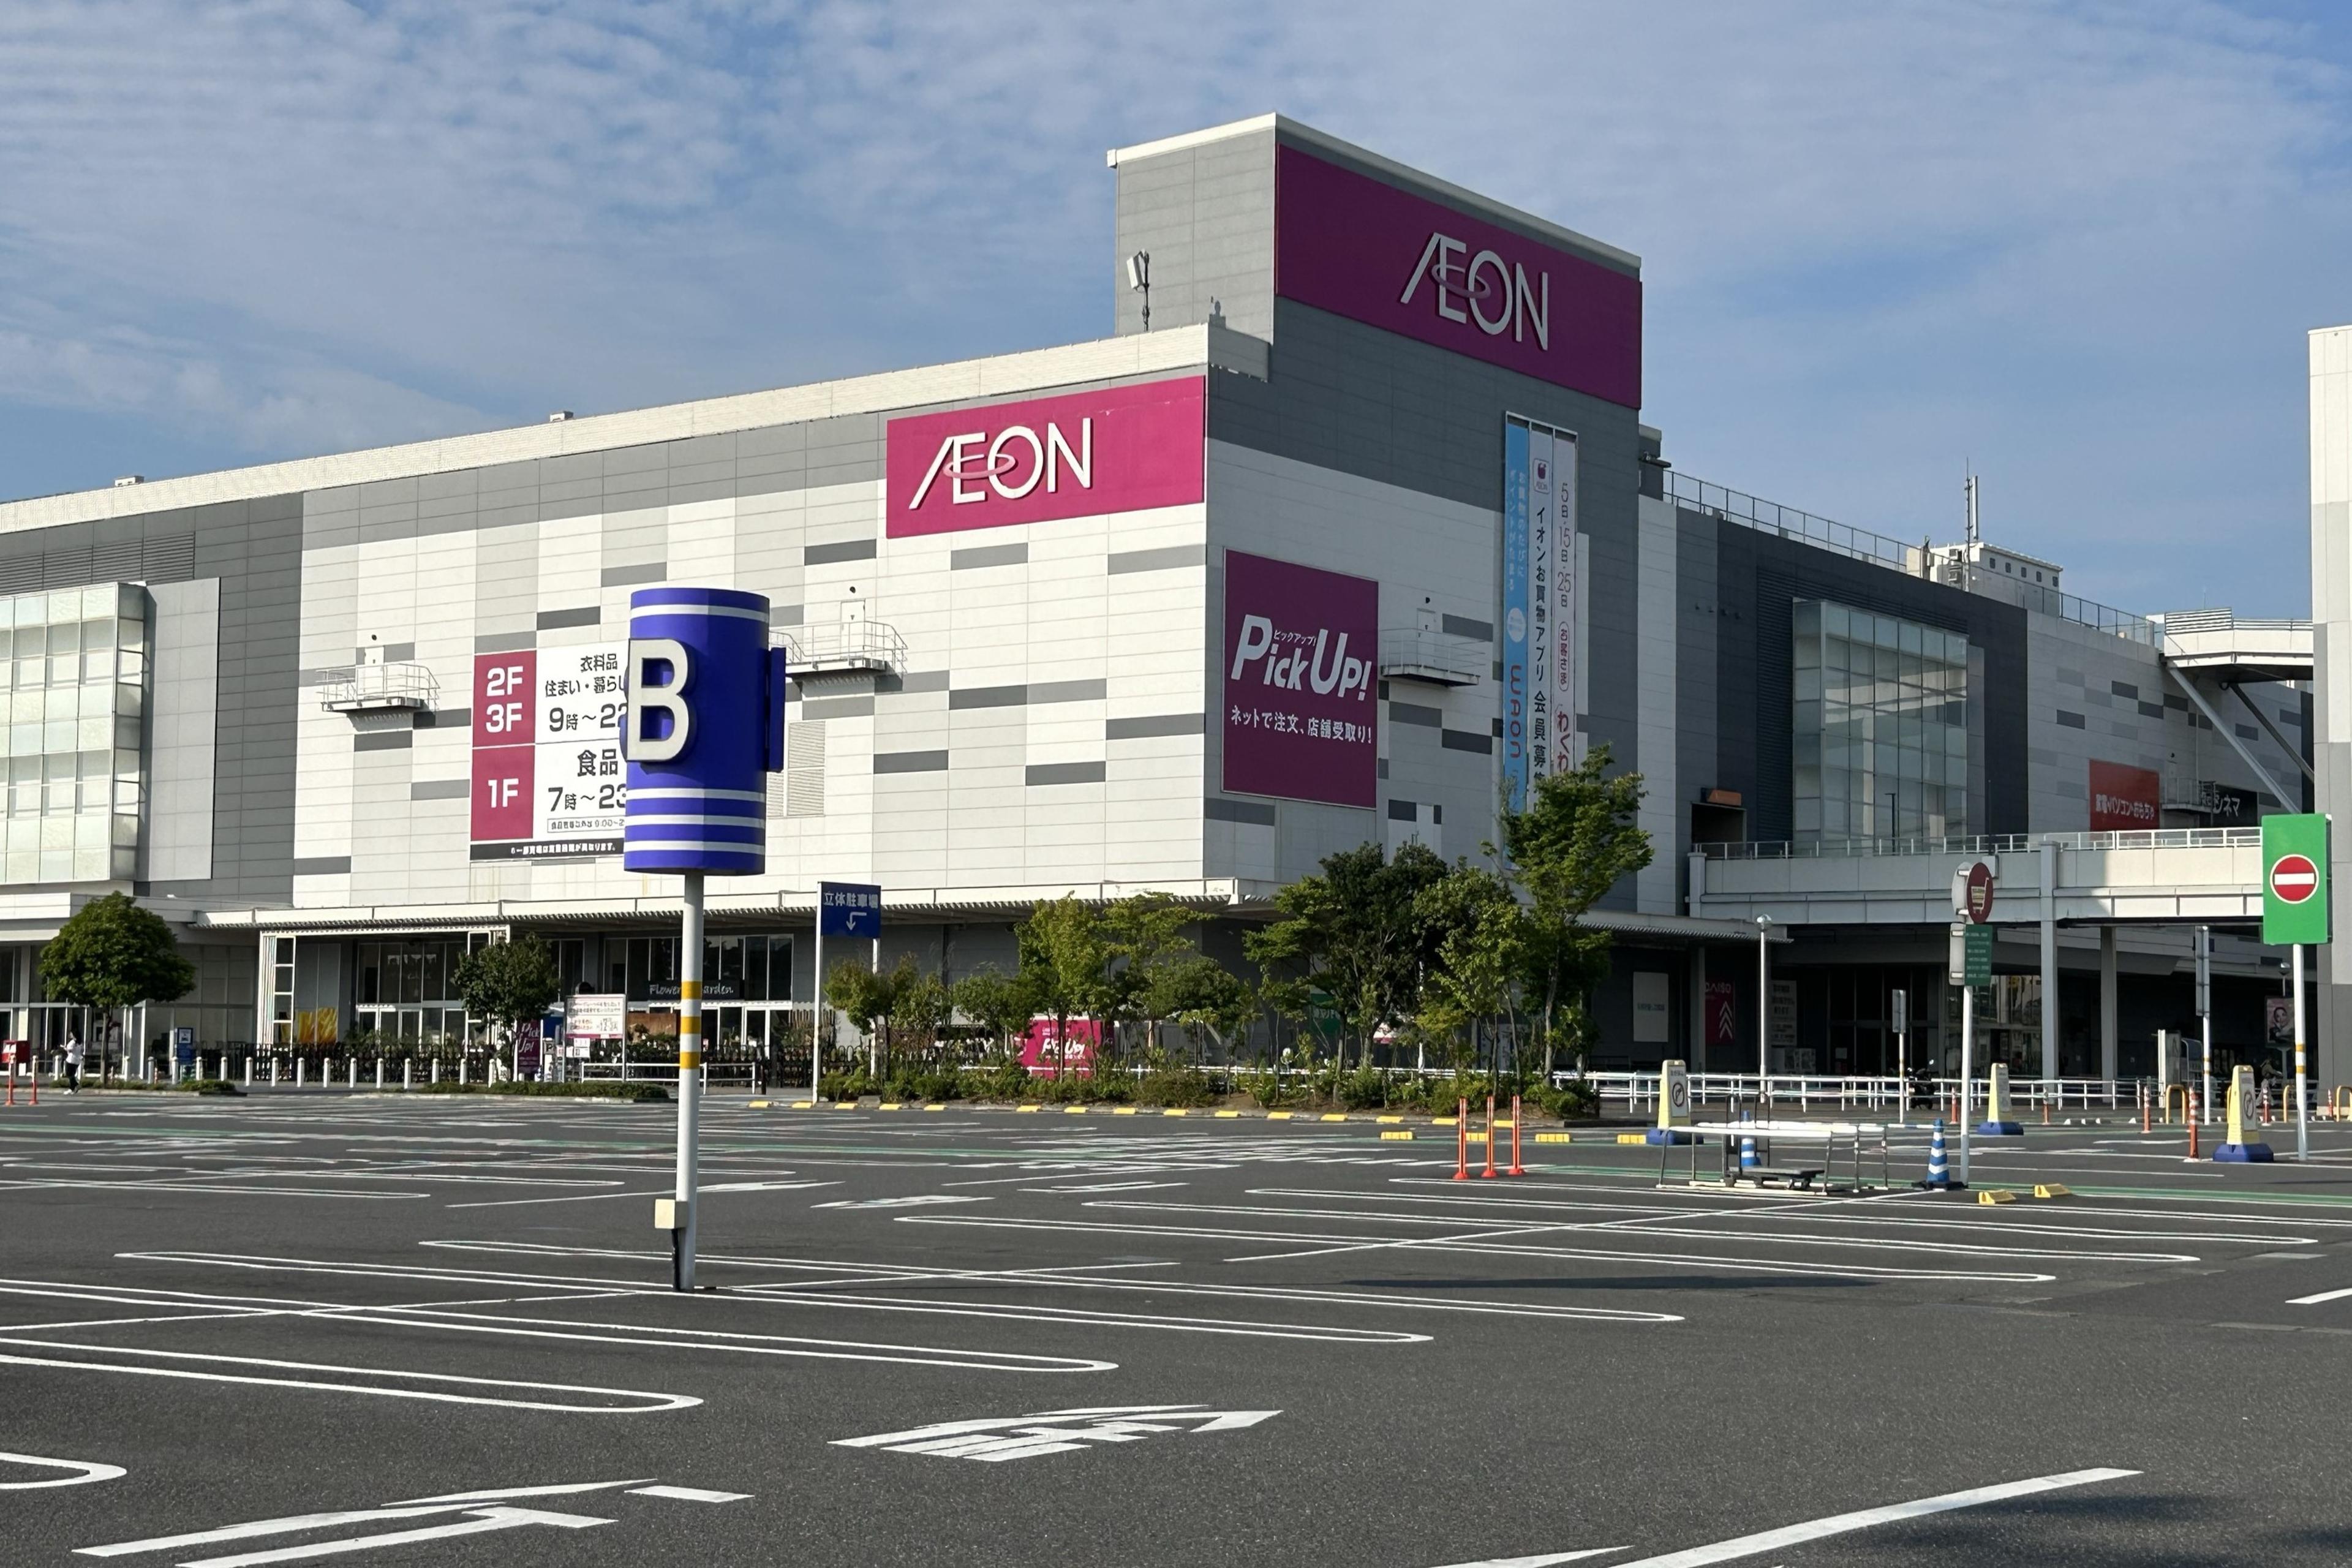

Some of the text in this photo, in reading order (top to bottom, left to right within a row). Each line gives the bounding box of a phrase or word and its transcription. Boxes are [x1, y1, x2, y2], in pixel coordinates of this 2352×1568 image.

[581, 653, 618, 673] 衣料品
[486, 666, 523, 696] 2F
[627, 638, 690, 763] B
[486, 703, 522, 733] 3F
[577, 749, 618, 777] 食品
[488, 778, 519, 808] 1F
